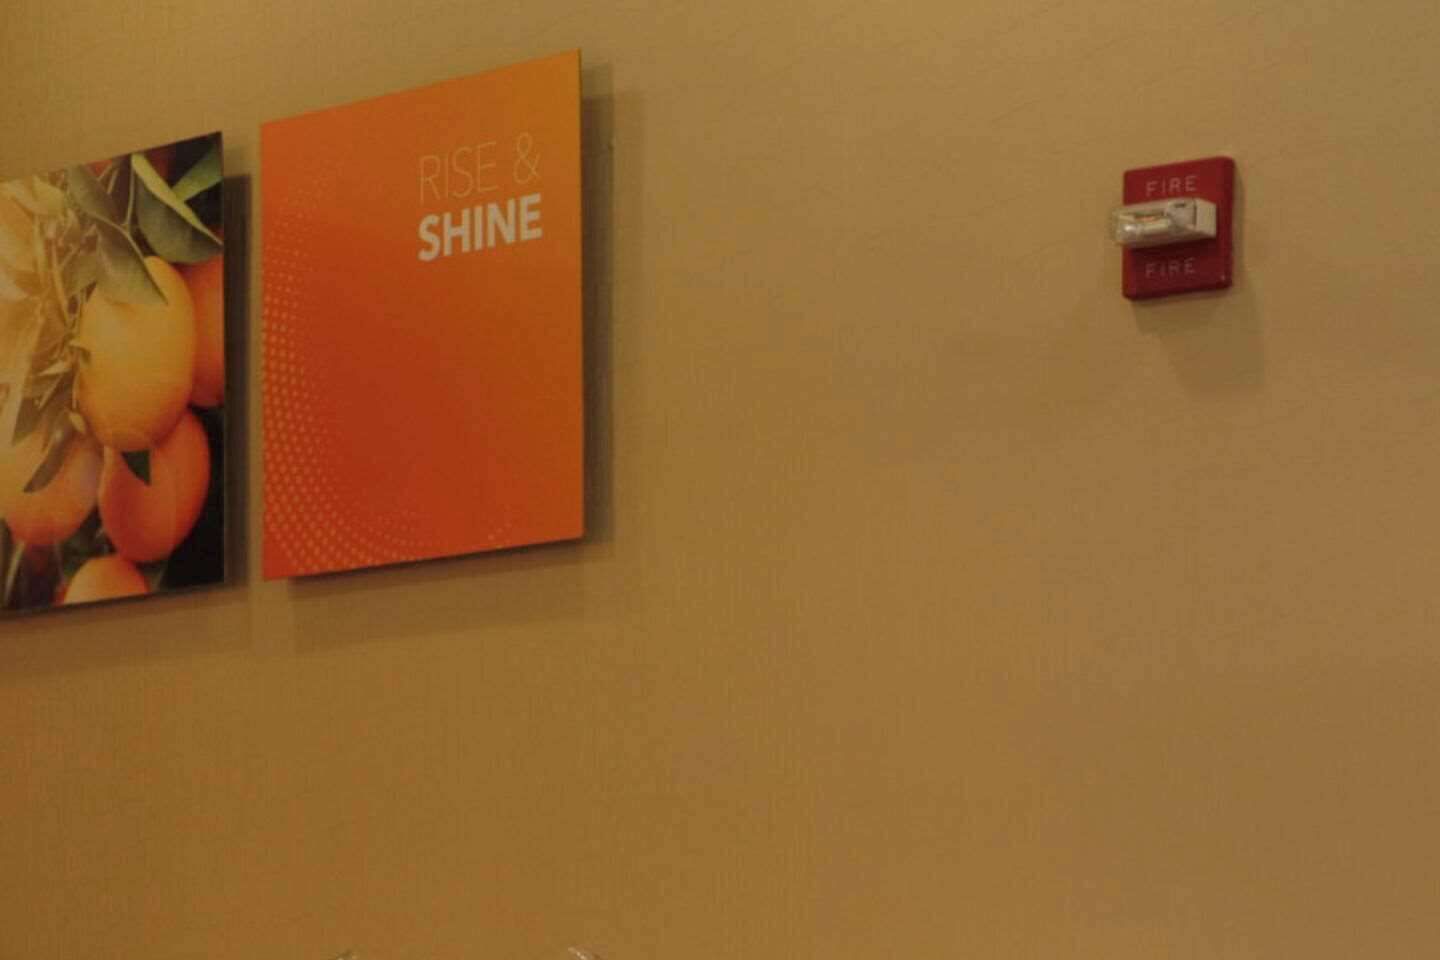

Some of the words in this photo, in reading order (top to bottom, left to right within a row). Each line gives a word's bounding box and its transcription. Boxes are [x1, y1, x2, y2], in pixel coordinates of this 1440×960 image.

[419, 140, 498, 206] RISE
[513, 131, 541, 184] &
[1145, 175, 1198, 197] FIRE
[418, 192, 542, 262] SHINE
[1145, 257, 1196, 279] FIRE
